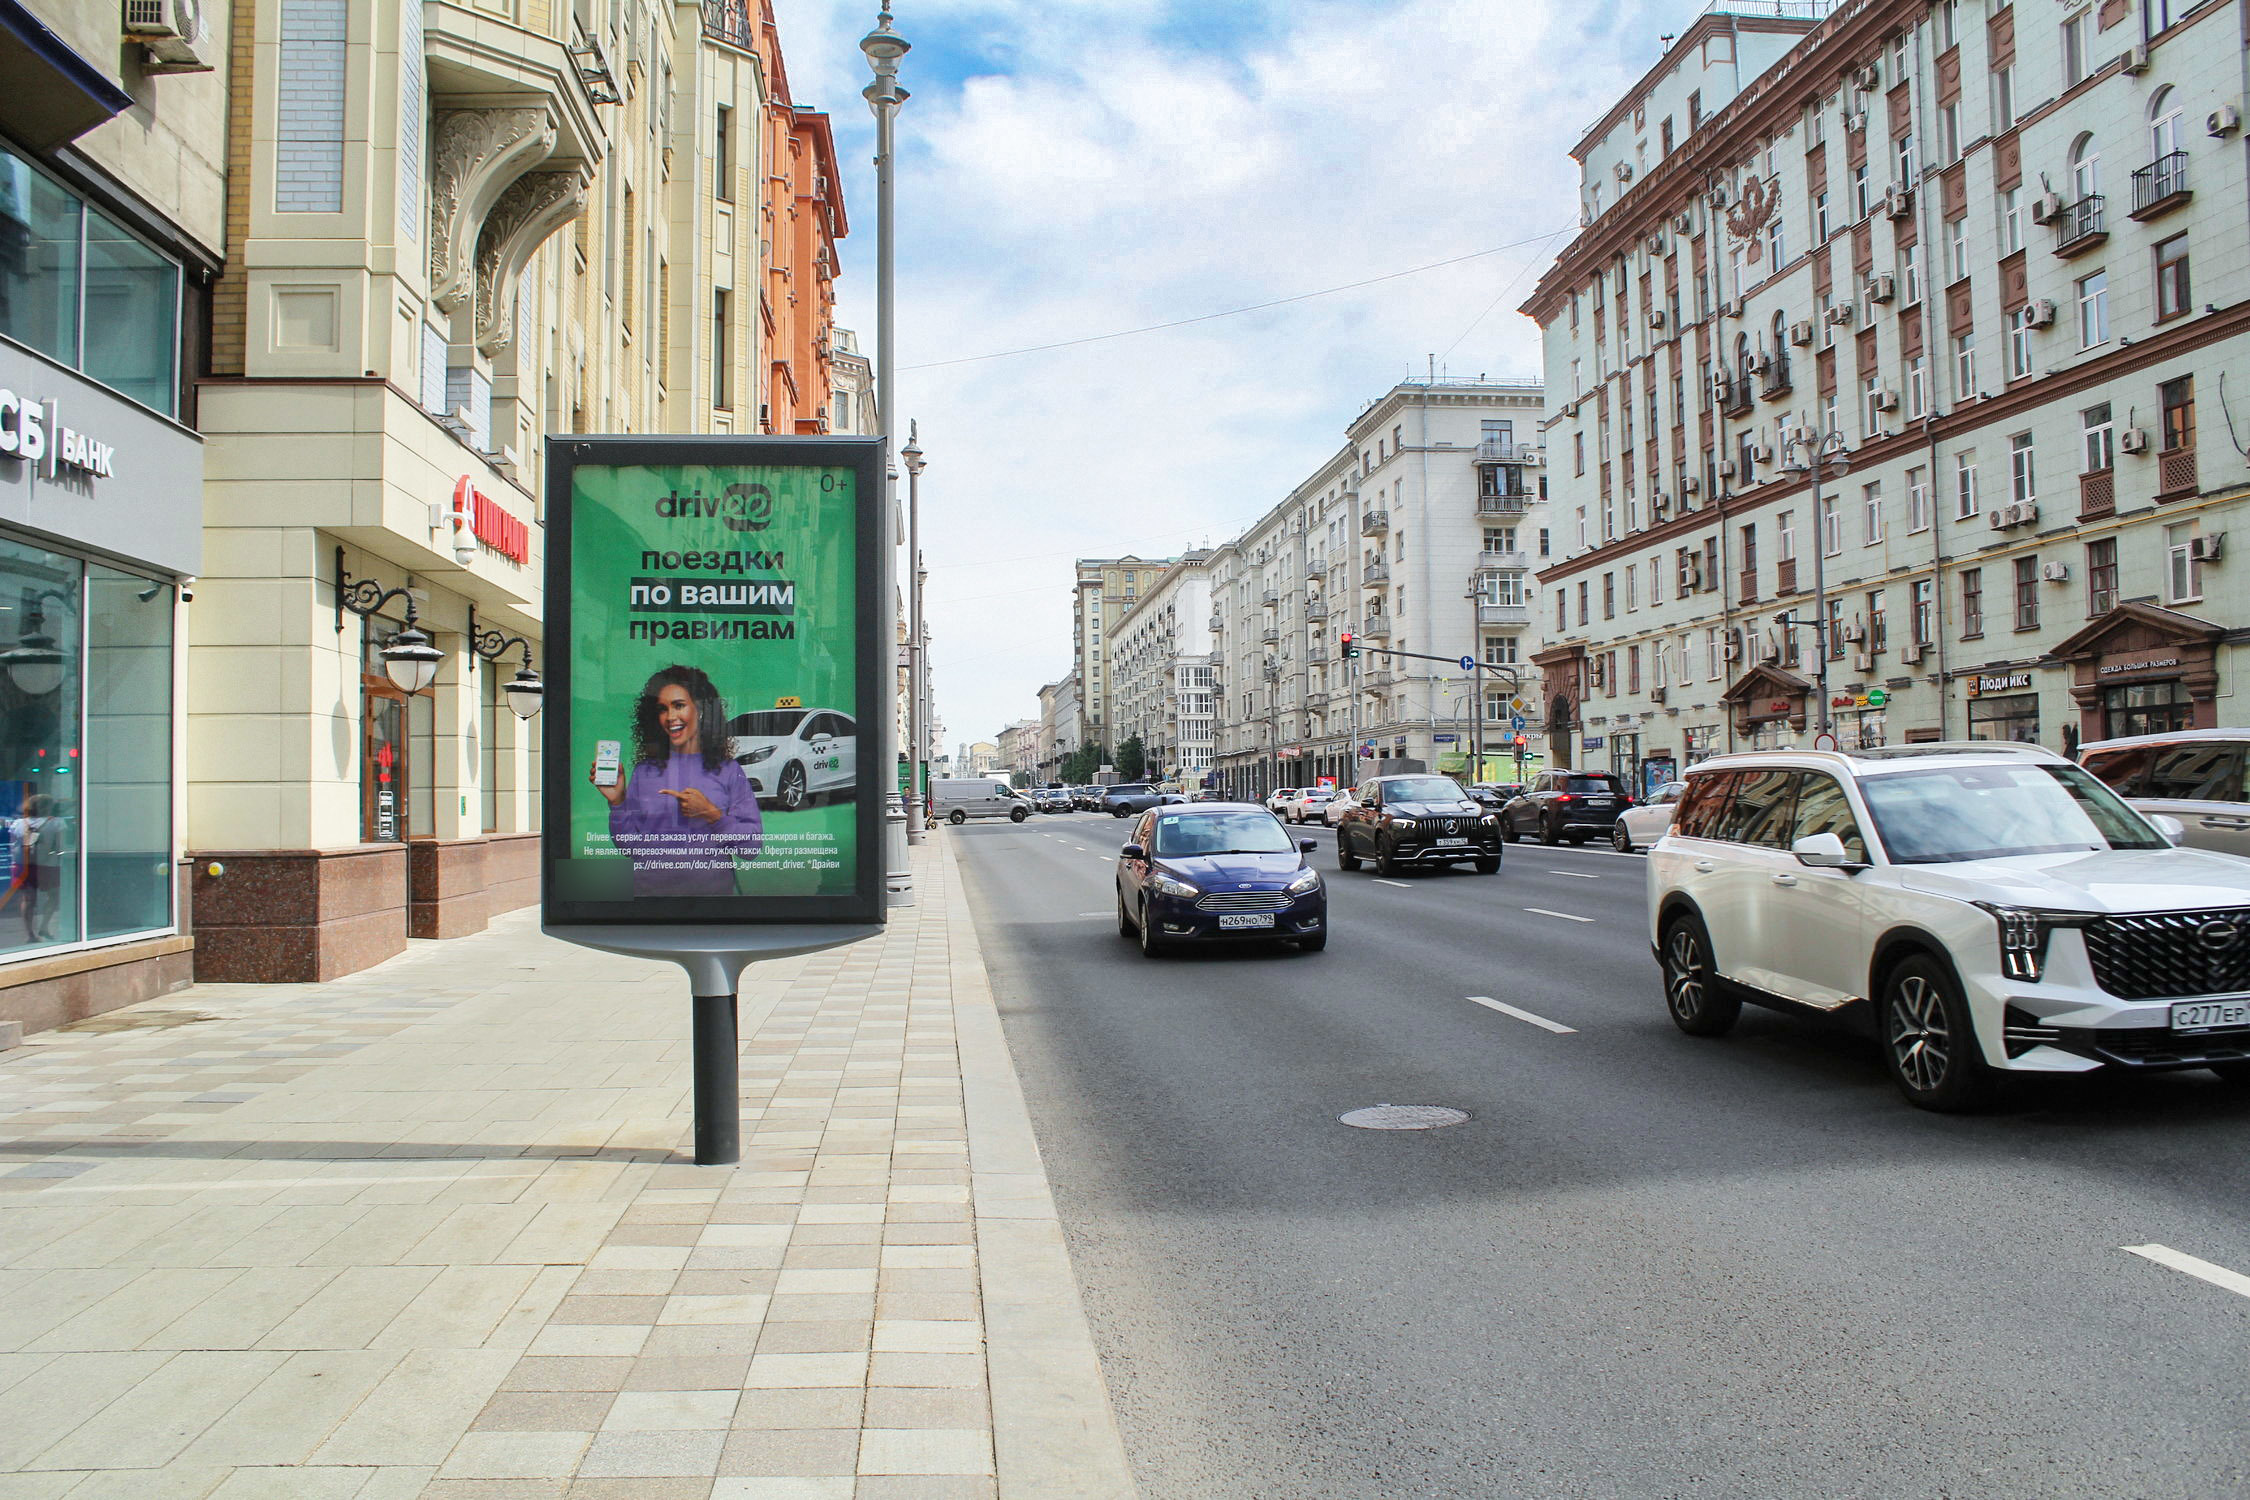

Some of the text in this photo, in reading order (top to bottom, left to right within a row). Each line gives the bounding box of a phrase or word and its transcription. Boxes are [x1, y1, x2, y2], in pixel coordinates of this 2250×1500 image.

[62, 427, 115, 478] БАНК
[820, 474, 848, 493] 0+
[655, 486, 772, 528] drivee
[641, 550, 784, 574] поездки
[630, 584, 794, 605] по вашим
[629, 620, 795, 646] правилам
[2100, 664, 2123, 674] ОДЕЖДА
[2149, 658, 2178, 669] РАЗМЕРОВ
[1979, 676, 2008, 691] ЛЮДИ
[2009, 674, 2029, 687] ИКС
[586, 832, 610, 842] Drivee
[615, 833, 643, 843] сервис
[643, 833, 659, 842] для
[660, 833, 687, 842] заказа
[688, 833, 709, 843] услуг
[710, 833, 751, 843] перевозки
[751, 833, 798, 843] пассажиров
[805, 831, 836, 841] багажа.
[583, 845, 838, 857] Не является перевозчиком или службой такси. Оферта размещена
[2177, 1004, 2245, 1026] С277ЕР
